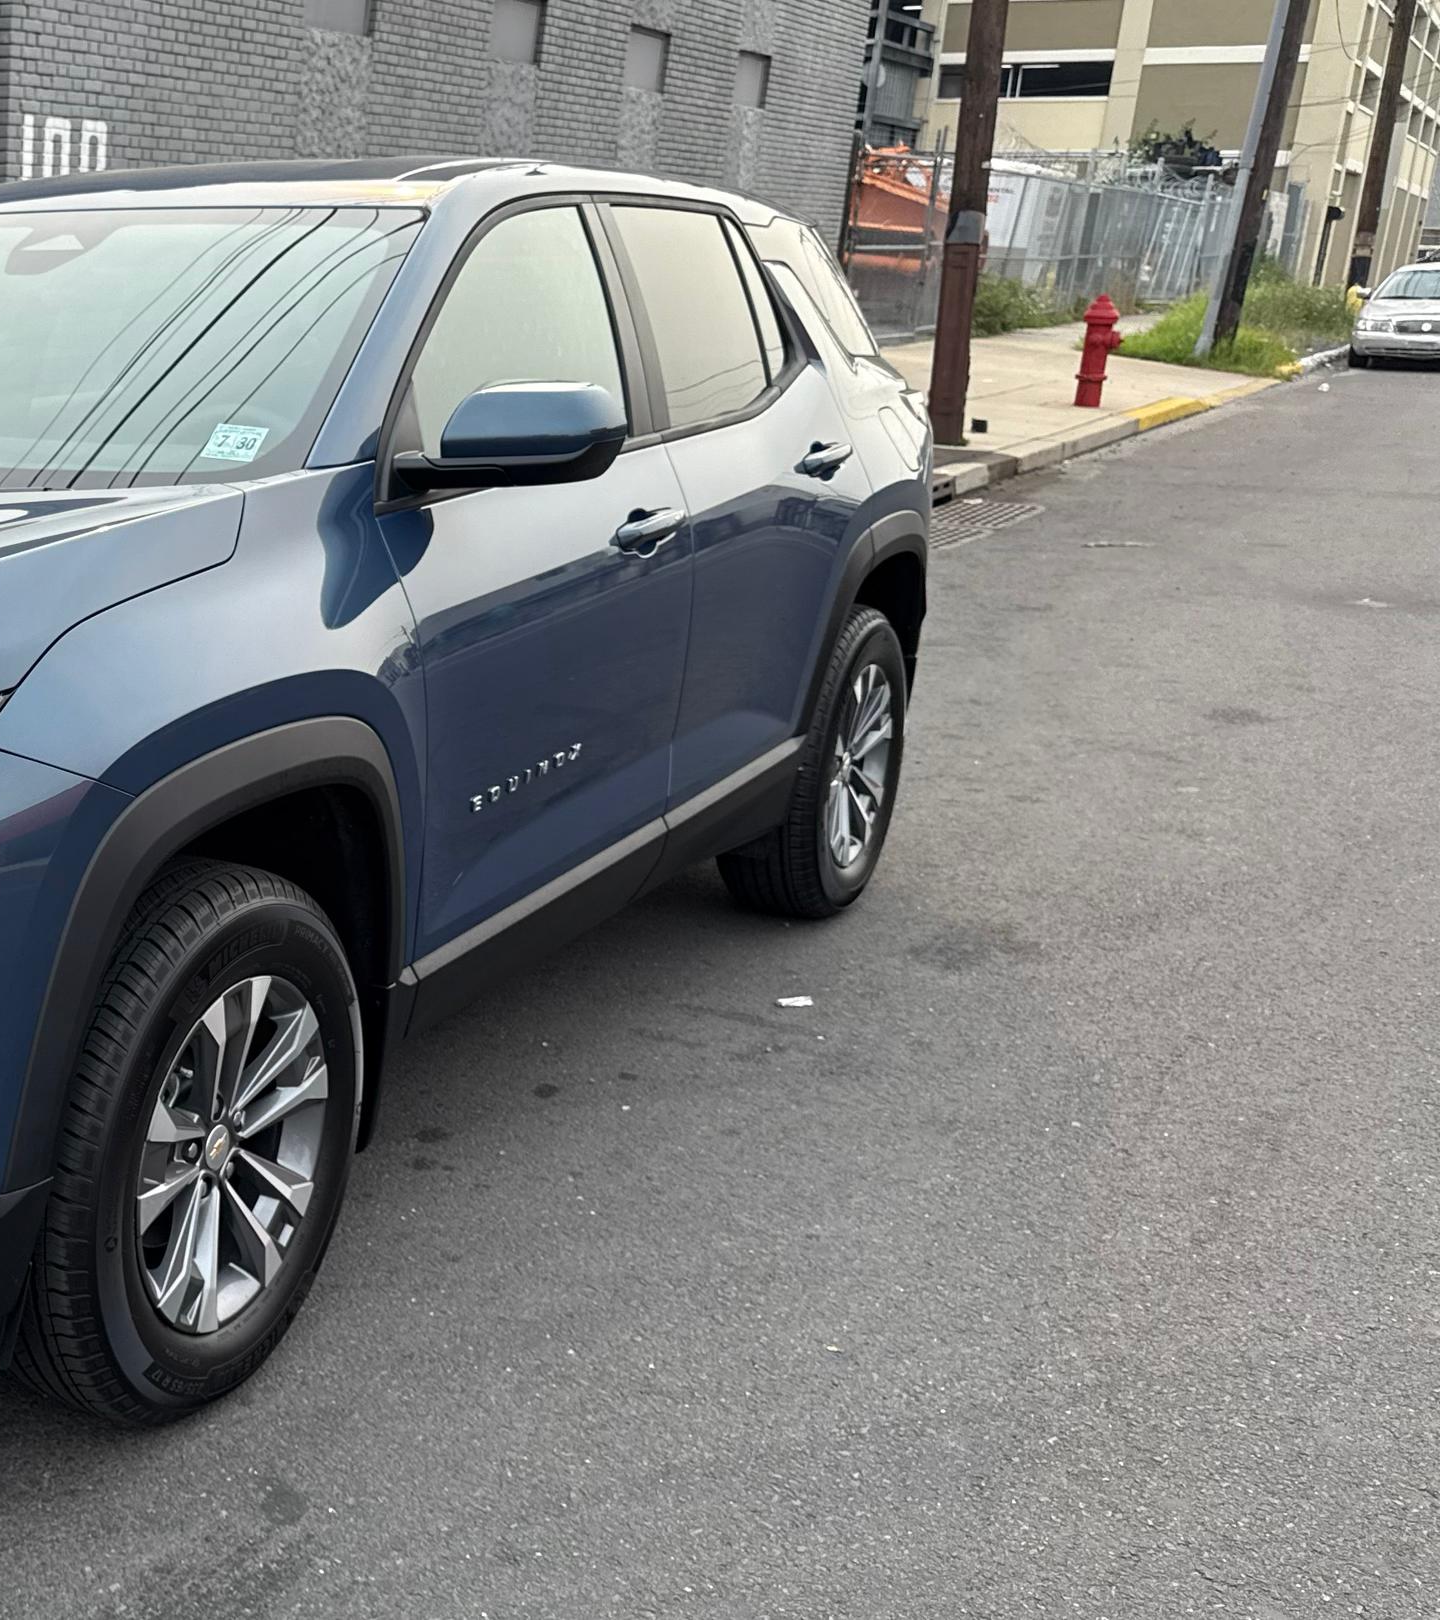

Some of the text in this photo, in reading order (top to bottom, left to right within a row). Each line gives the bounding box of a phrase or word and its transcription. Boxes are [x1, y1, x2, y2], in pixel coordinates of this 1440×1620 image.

[217, 434, 257, 450] 7 30
[469, 742, 582, 813] EQUINOX
